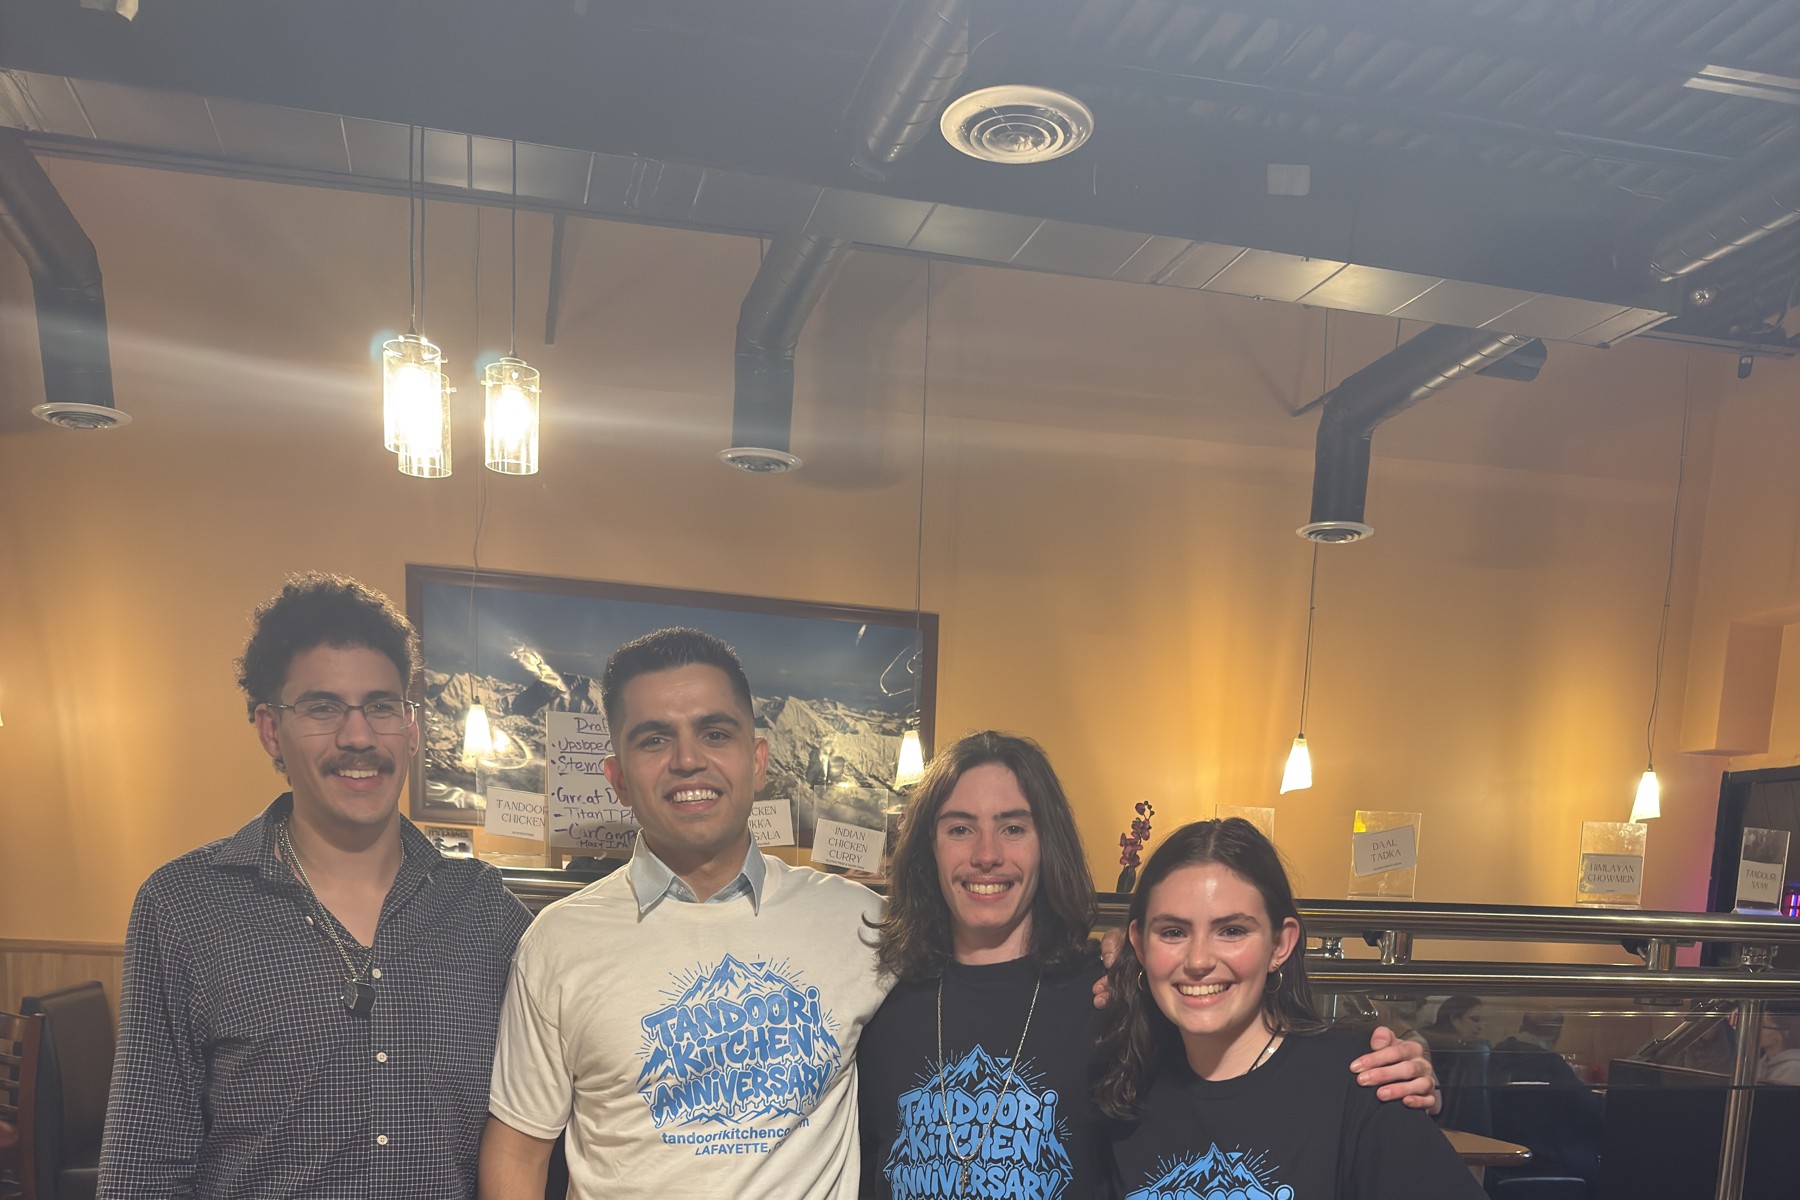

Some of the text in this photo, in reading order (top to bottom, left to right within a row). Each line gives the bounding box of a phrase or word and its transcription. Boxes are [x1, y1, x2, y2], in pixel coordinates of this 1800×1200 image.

[573, 717, 608, 733] Draf
[557, 755, 598, 773] Stem
[564, 806, 604, 820] Titan
[751, 805, 777, 816] CKEN
[501, 812, 546, 827] CHICKEN
[754, 830, 781, 841] SALA
[834, 826, 866, 841] INDIAN
[828, 837, 868, 853] CHICKEN
[1372, 838, 1398, 851] DAAL
[829, 849, 863, 864] CURRY
[1371, 848, 1401, 862] TADKA
[695, 1142, 772, 1156] LAFAYETTE,
